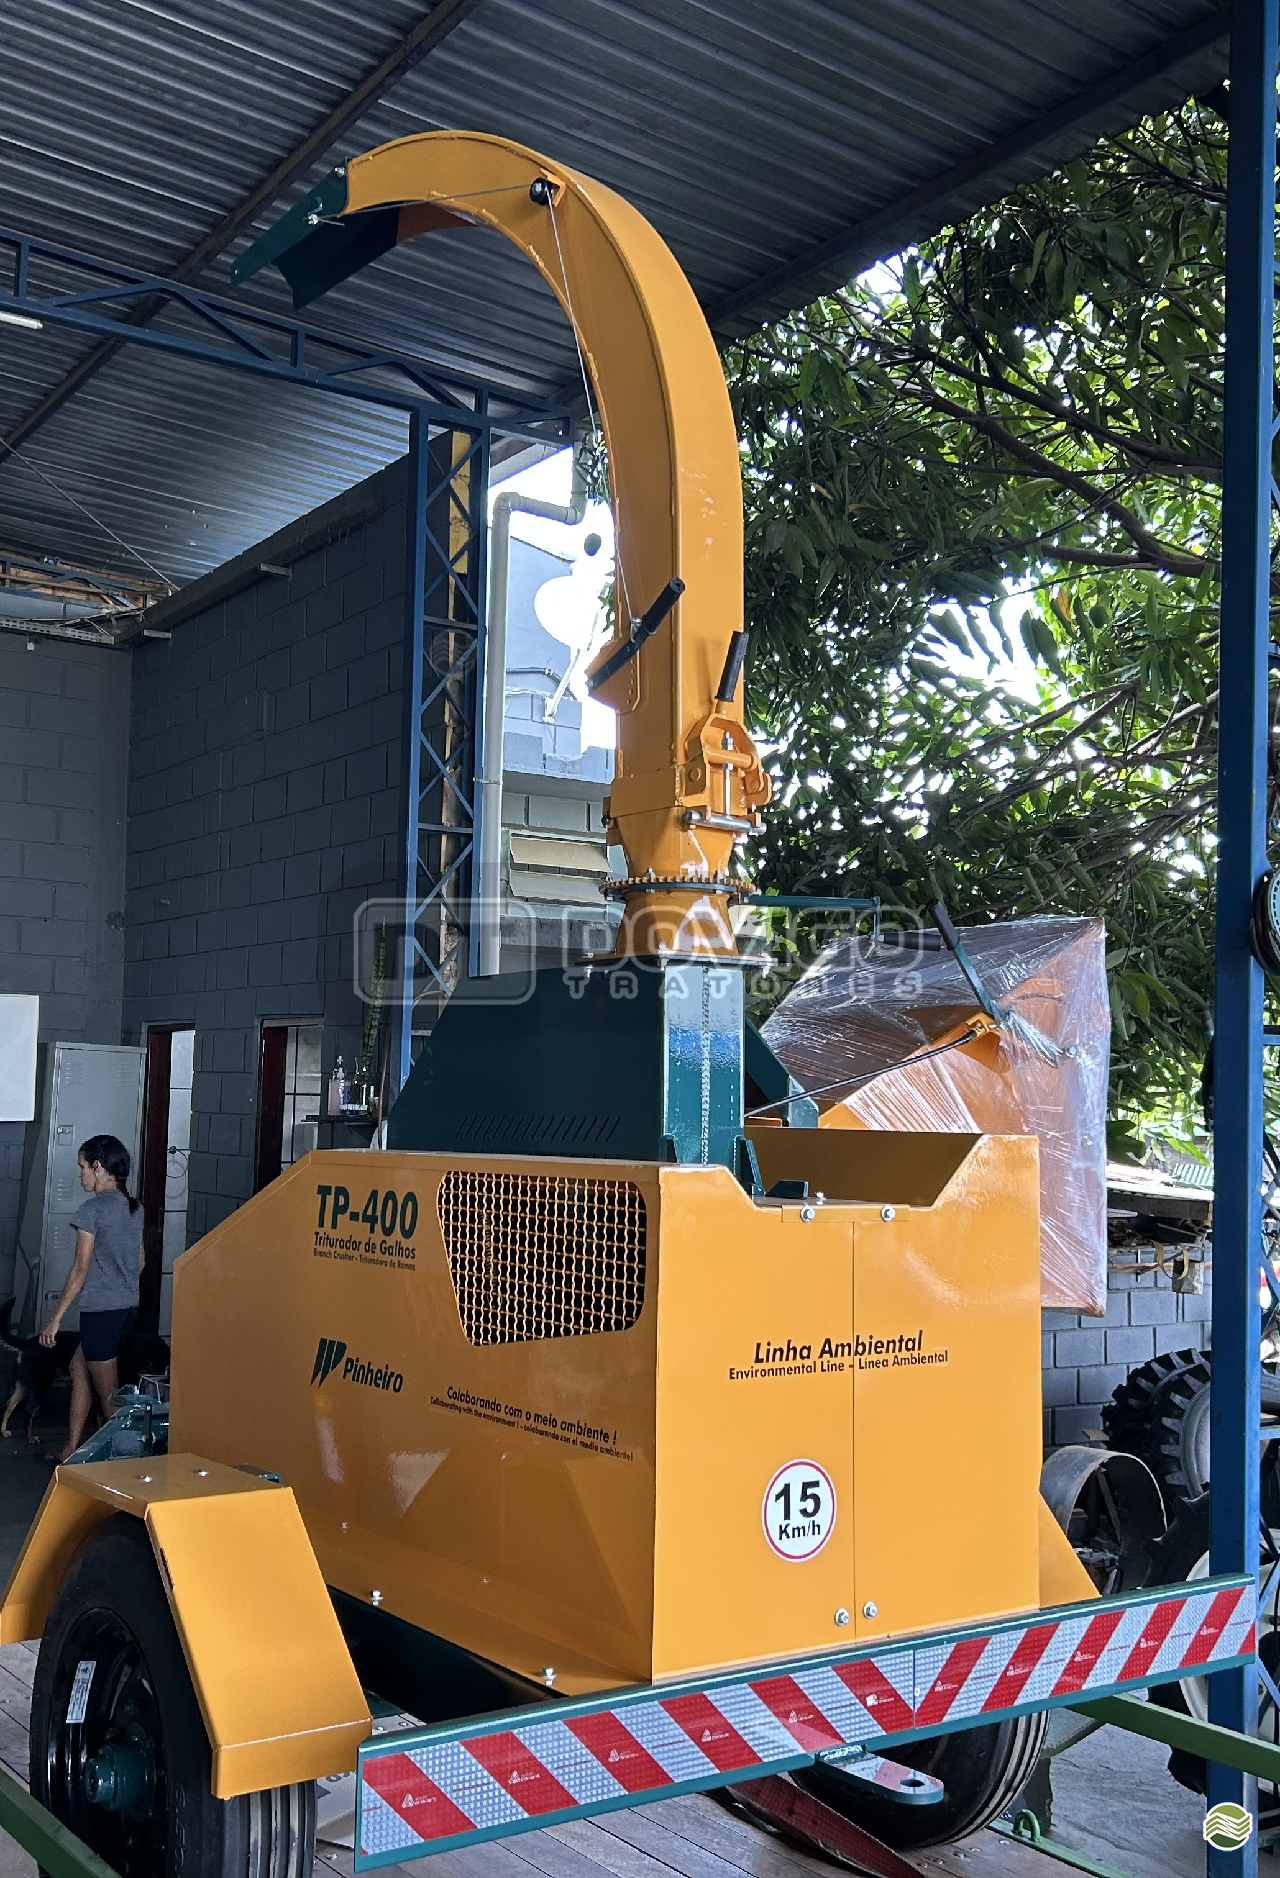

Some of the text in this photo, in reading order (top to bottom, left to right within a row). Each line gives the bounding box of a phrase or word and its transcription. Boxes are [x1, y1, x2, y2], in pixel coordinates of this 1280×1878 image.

[316, 1184, 418, 1240] TP-400
[313, 1231, 416, 1260] Triturador de Galhos
[313, 1247, 333, 1260] Branch
[333, 1250, 355, 1262] Crusher
[389, 1258, 396, 1269] de
[754, 1329, 923, 1363] Linha Ambiental
[342, 1356, 404, 1393] Pinheiro
[729, 1360, 817, 1380] Environmental
[820, 1359, 845, 1373] Line
[892, 1349, 948, 1368] Ambiental
[447, 1385, 502, 1413] Colaborando
[504, 1404, 523, 1419] com
[525, 1410, 532, 1421] o
[533, 1412, 558, 1429] meio
[560, 1420, 610, 1443] ambiente
[463, 1406, 474, 1416] with
[474, 1409, 483, 1419] the
[483, 1412, 516, 1428] environment
[523, 1424, 560, 1441] colaborando
[560, 1435, 571, 1445] con
[571, 1437, 578, 1446] el
[579, 1440, 599, 1452] medio
[773, 1479, 822, 1521] 15
[778, 1520, 821, 1541] Km/h
